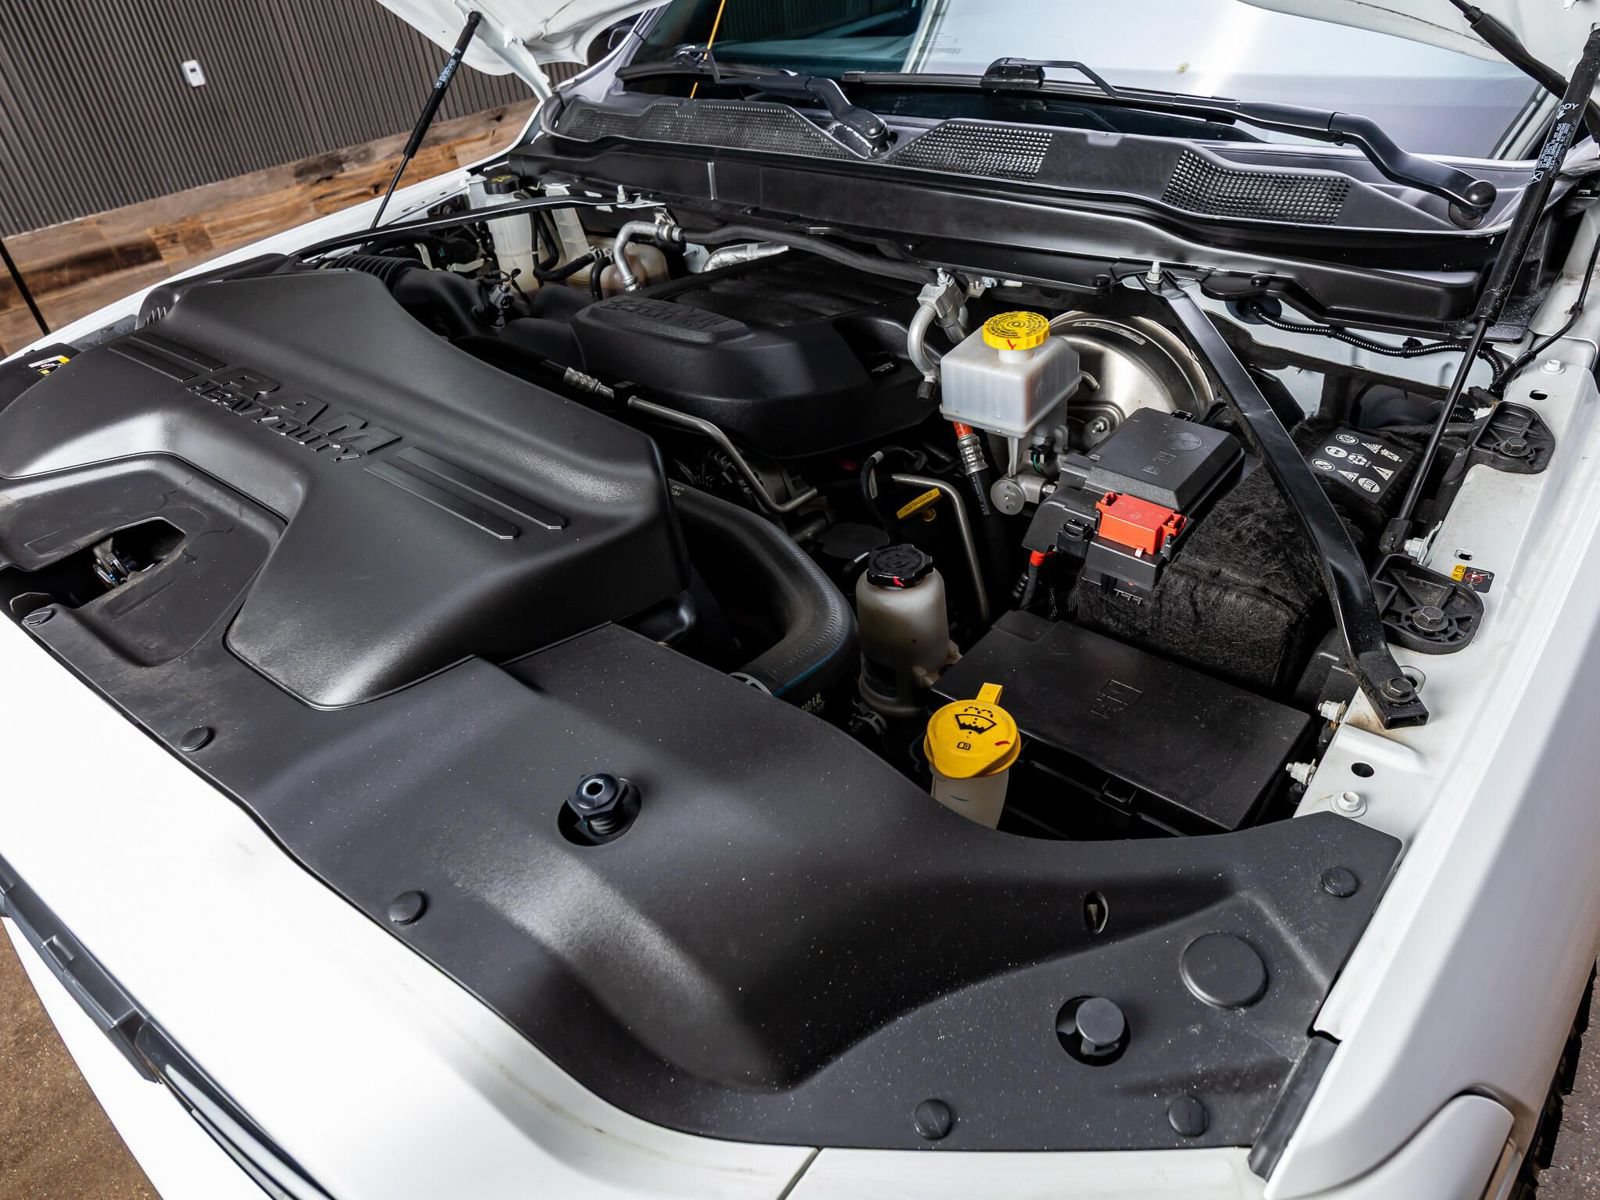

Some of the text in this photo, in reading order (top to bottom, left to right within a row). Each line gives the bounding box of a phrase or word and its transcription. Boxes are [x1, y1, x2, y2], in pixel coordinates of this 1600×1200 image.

[186, 380, 361, 463] HEAVY DUTY
[208, 367, 403, 455] RAM
